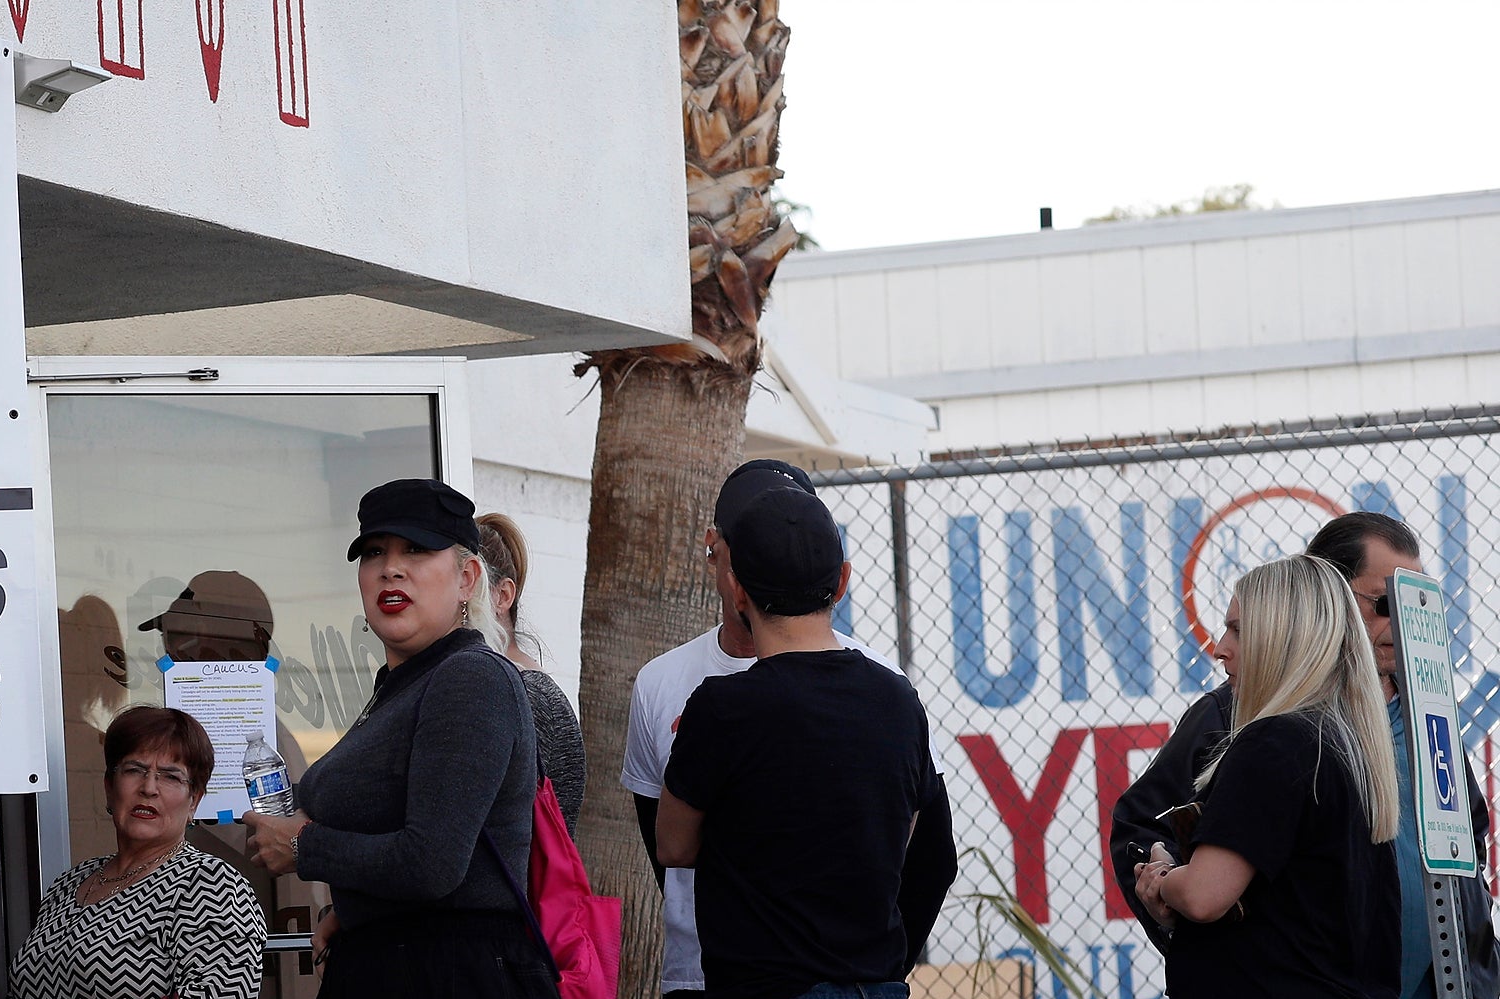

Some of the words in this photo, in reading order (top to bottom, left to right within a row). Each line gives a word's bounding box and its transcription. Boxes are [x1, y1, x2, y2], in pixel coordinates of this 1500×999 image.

[1403, 604, 1446, 648] RESERVED
[201, 663, 260, 676] CAUCUS
[1414, 656, 1449, 697] PARKING
